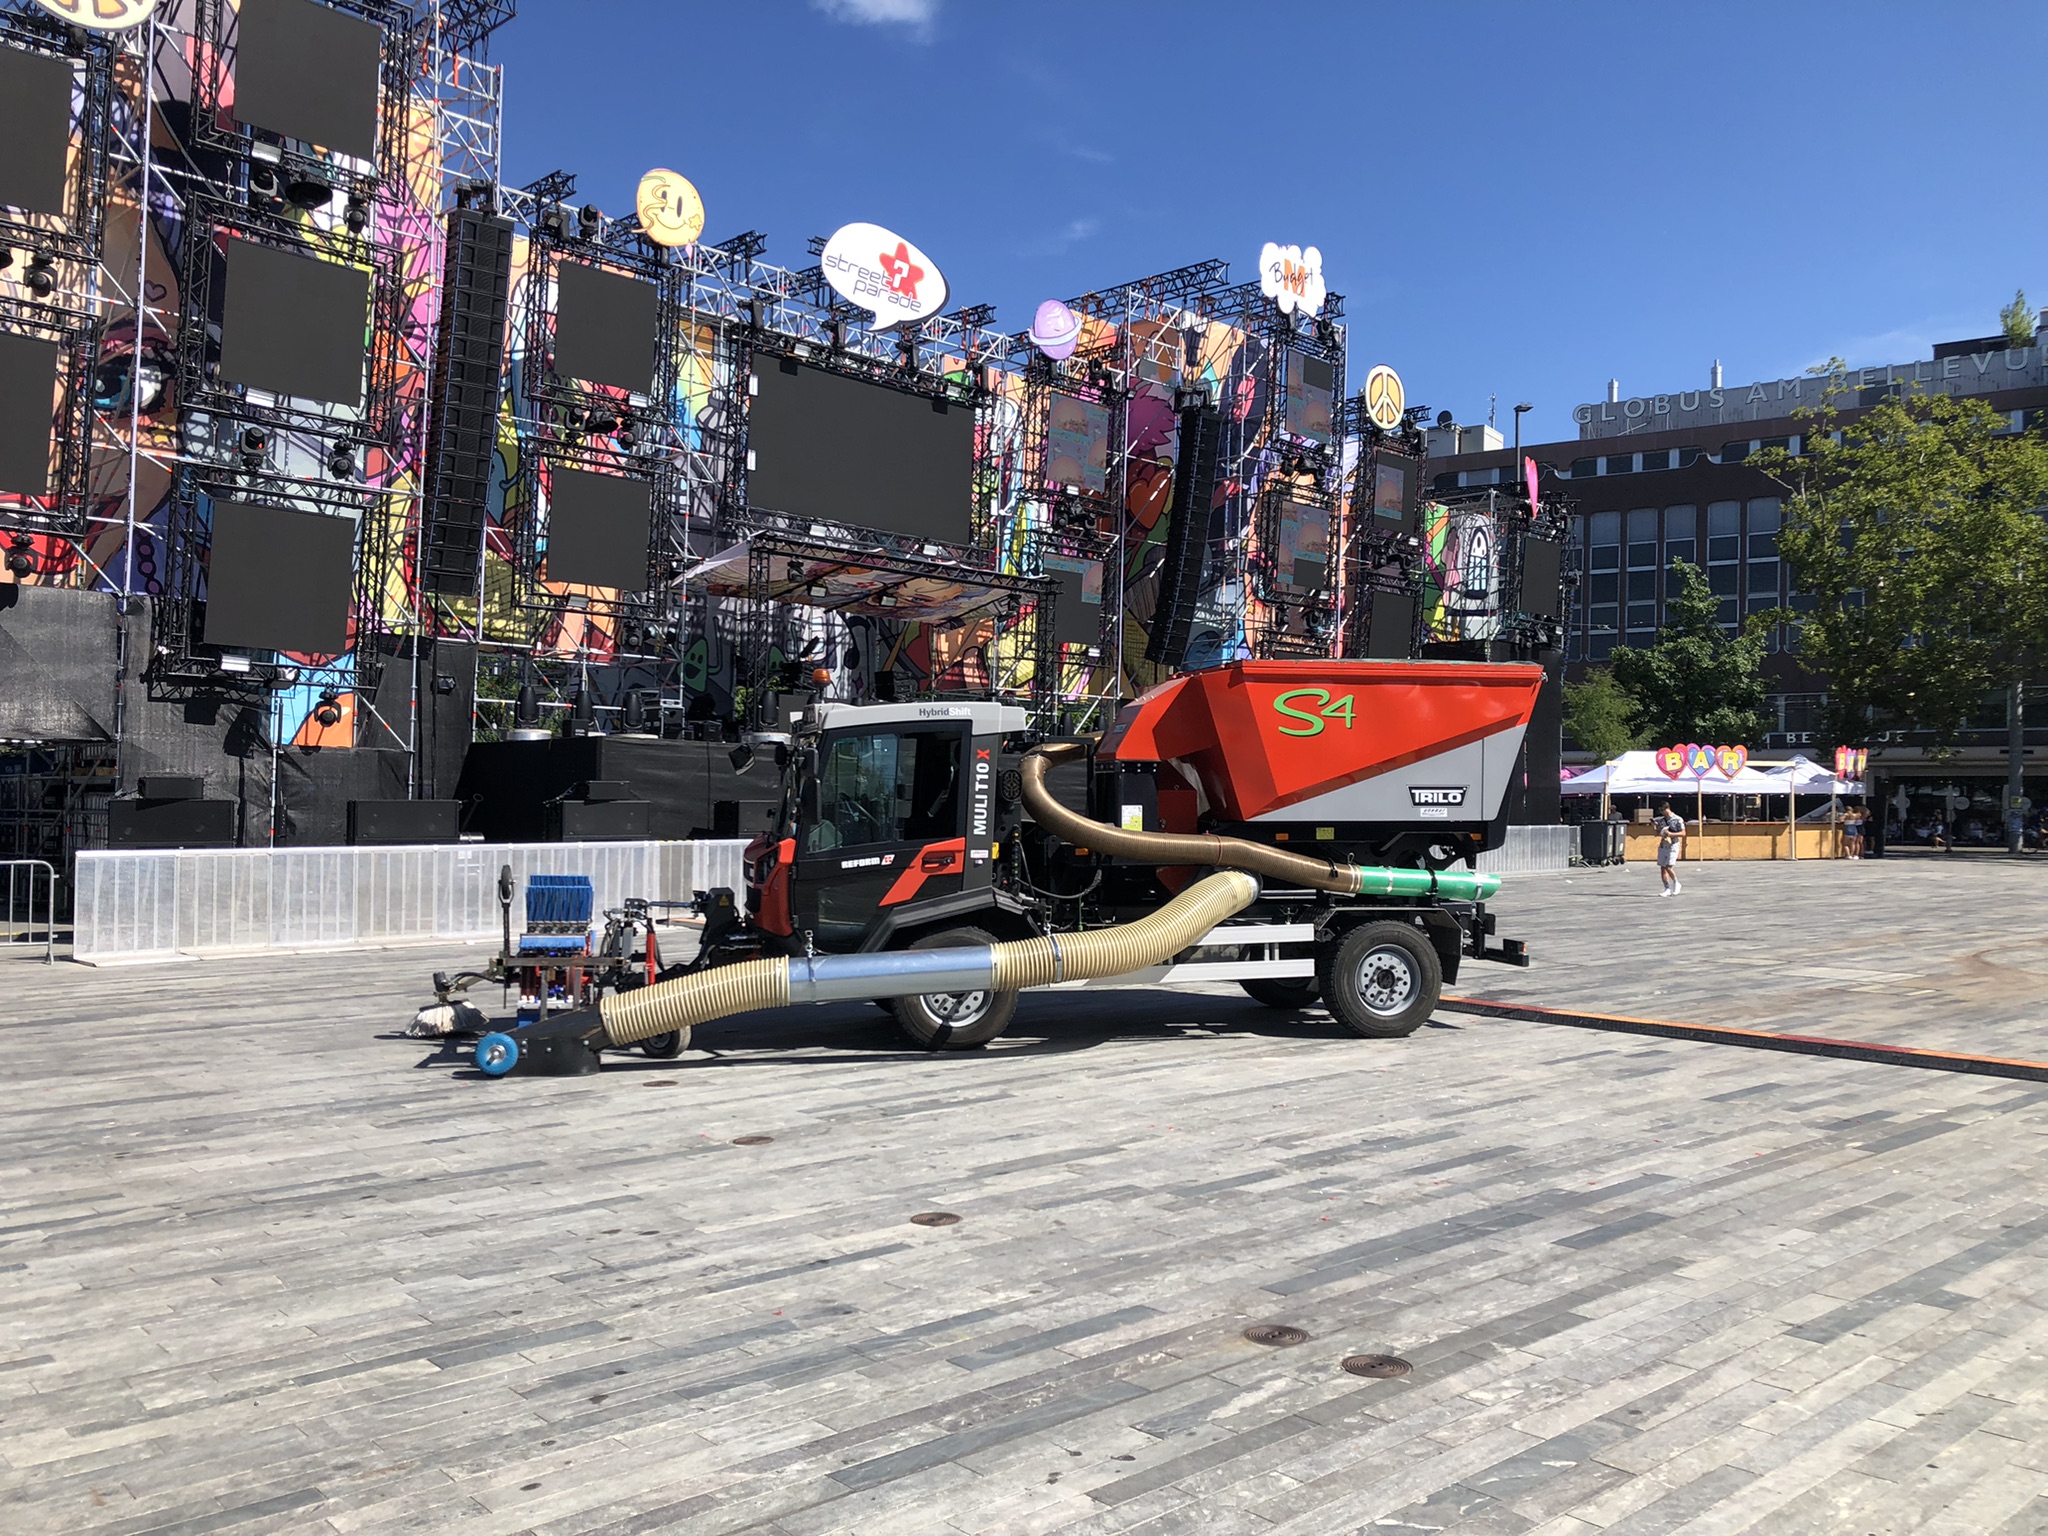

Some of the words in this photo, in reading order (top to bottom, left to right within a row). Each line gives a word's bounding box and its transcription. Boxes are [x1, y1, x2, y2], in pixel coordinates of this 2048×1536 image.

[825, 253, 893, 289] street
[1269, 261, 1313, 296] Budget
[853, 279, 921, 312] parade
[1573, 387, 1725, 424] GLOBUS
[1746, 376, 1801, 404] AM
[1273, 688, 1356, 737] S4
[976, 749, 991, 760] X
[1664, 751, 1740, 771] BAR
[975, 762, 990, 792] T10
[1411, 789, 1463, 803] TRILO
[973, 795, 988, 836] MULI
[841, 857, 880, 869] REFORM
